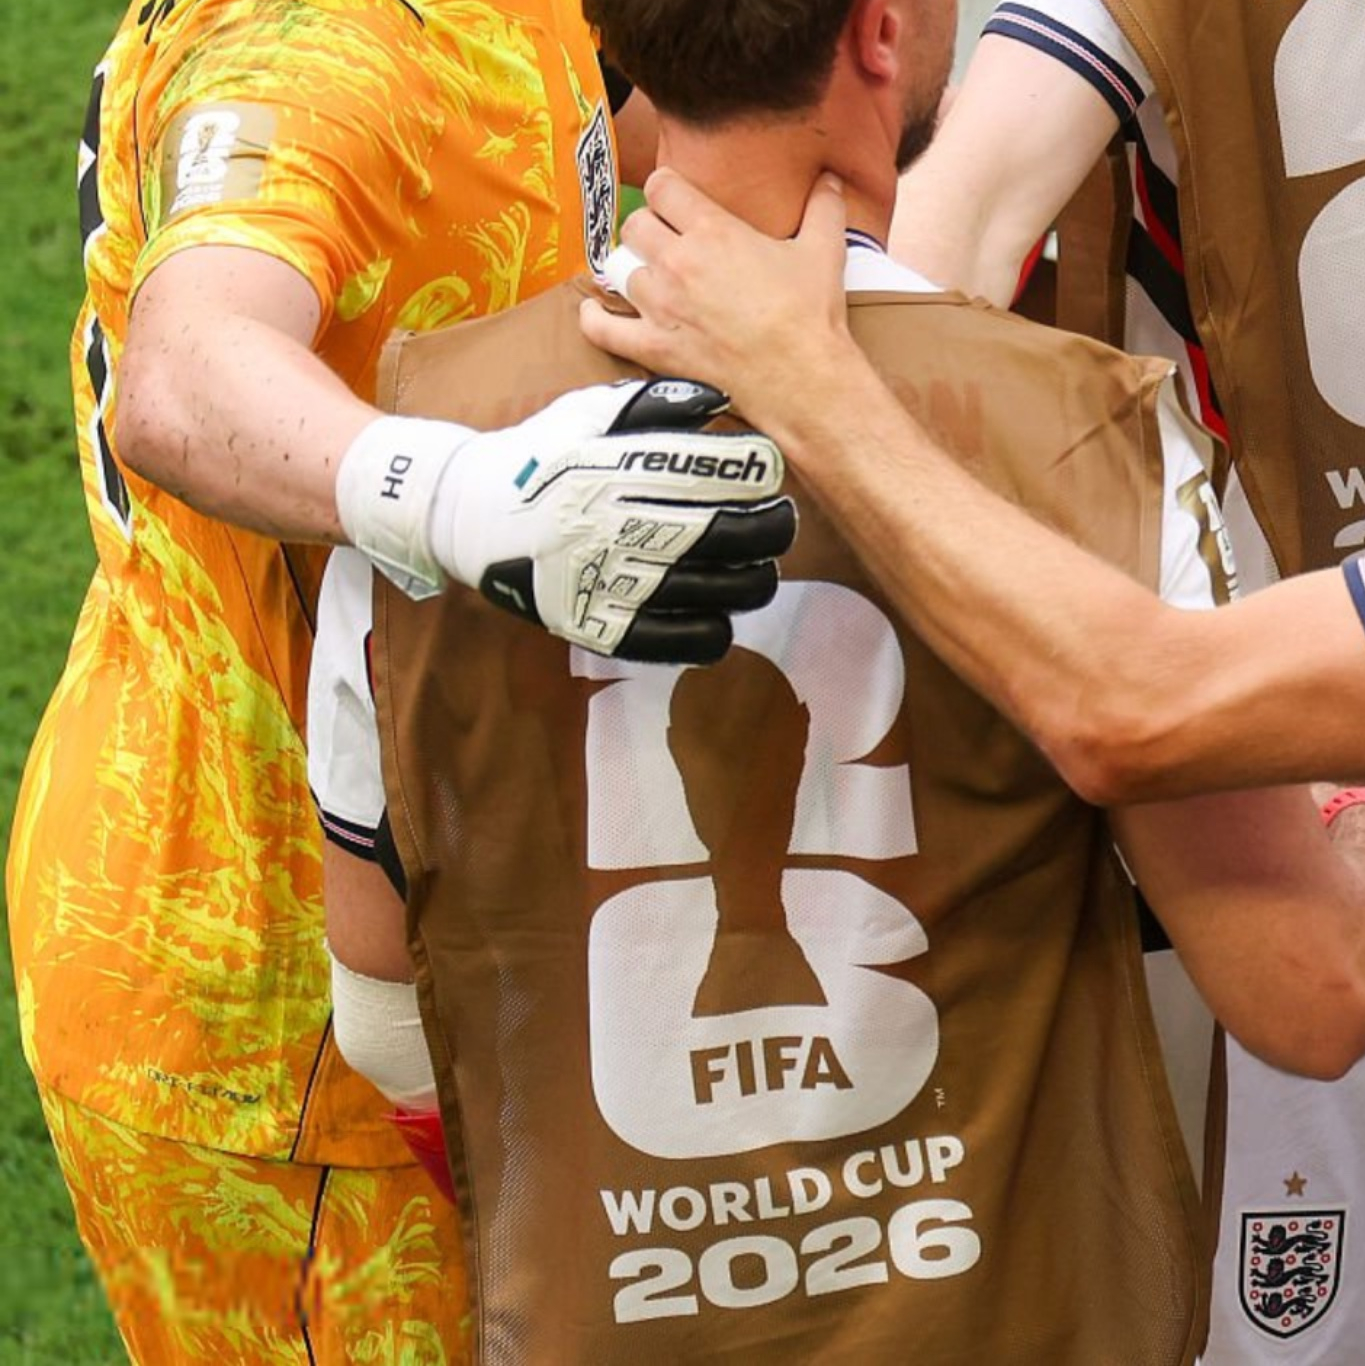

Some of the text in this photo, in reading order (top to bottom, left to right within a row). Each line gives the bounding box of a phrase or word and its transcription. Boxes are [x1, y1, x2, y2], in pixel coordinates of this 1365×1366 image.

[380, 454, 412, 502] DH
[624, 451, 767, 484] reusch
[690, 1036, 854, 1105] FIFA
[598, 1135, 965, 1237] WORLD CUP
[607, 1198, 982, 1324] 2026
